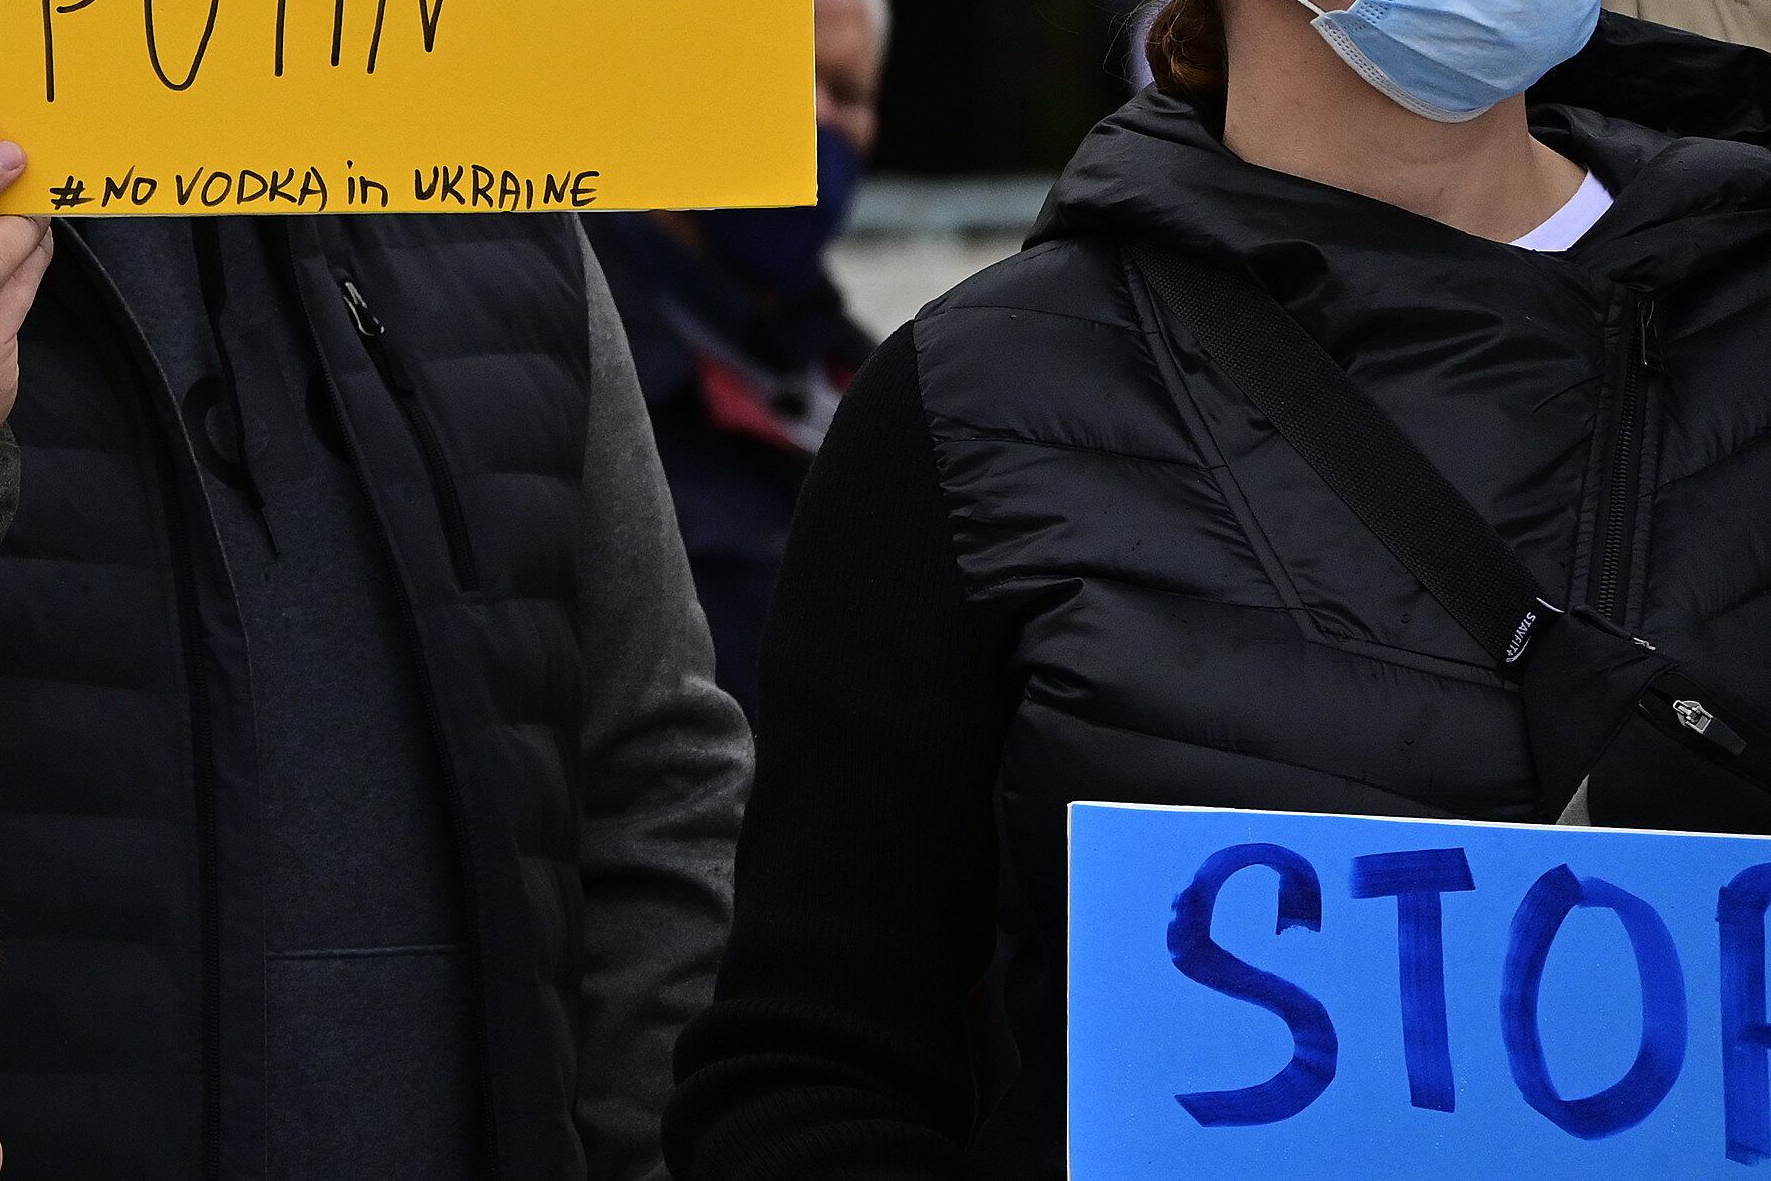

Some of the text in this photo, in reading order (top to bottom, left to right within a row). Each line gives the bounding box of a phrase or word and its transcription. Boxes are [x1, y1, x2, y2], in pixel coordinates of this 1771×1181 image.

[175, 166, 328, 211] VODKA
[346, 159, 389, 208] in
[414, 164, 601, 210] UKRAINE
